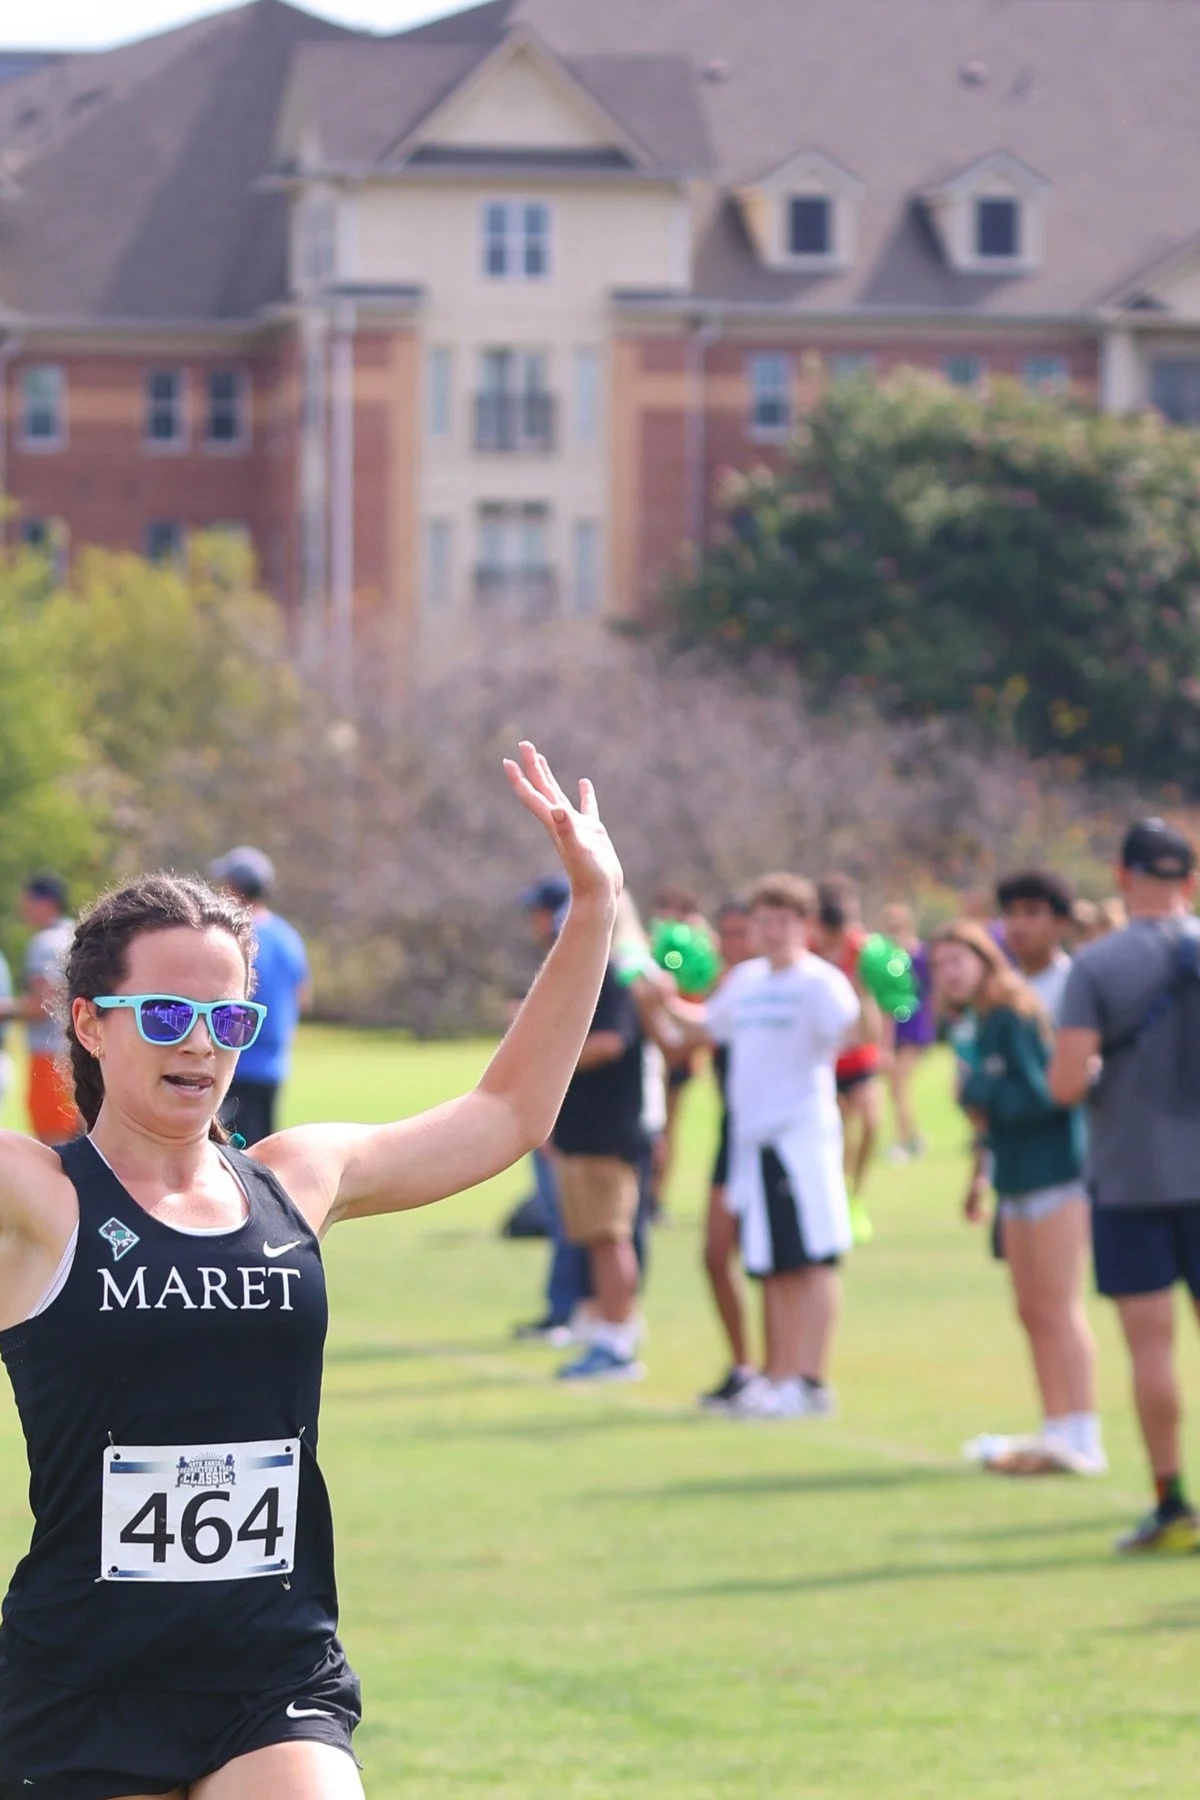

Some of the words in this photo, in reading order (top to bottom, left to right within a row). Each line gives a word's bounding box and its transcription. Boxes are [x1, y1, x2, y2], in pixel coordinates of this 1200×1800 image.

[97, 1266, 301, 1311] MARET
[182, 1471, 230, 1485] CLASSIC
[119, 1486, 285, 1564] 464
